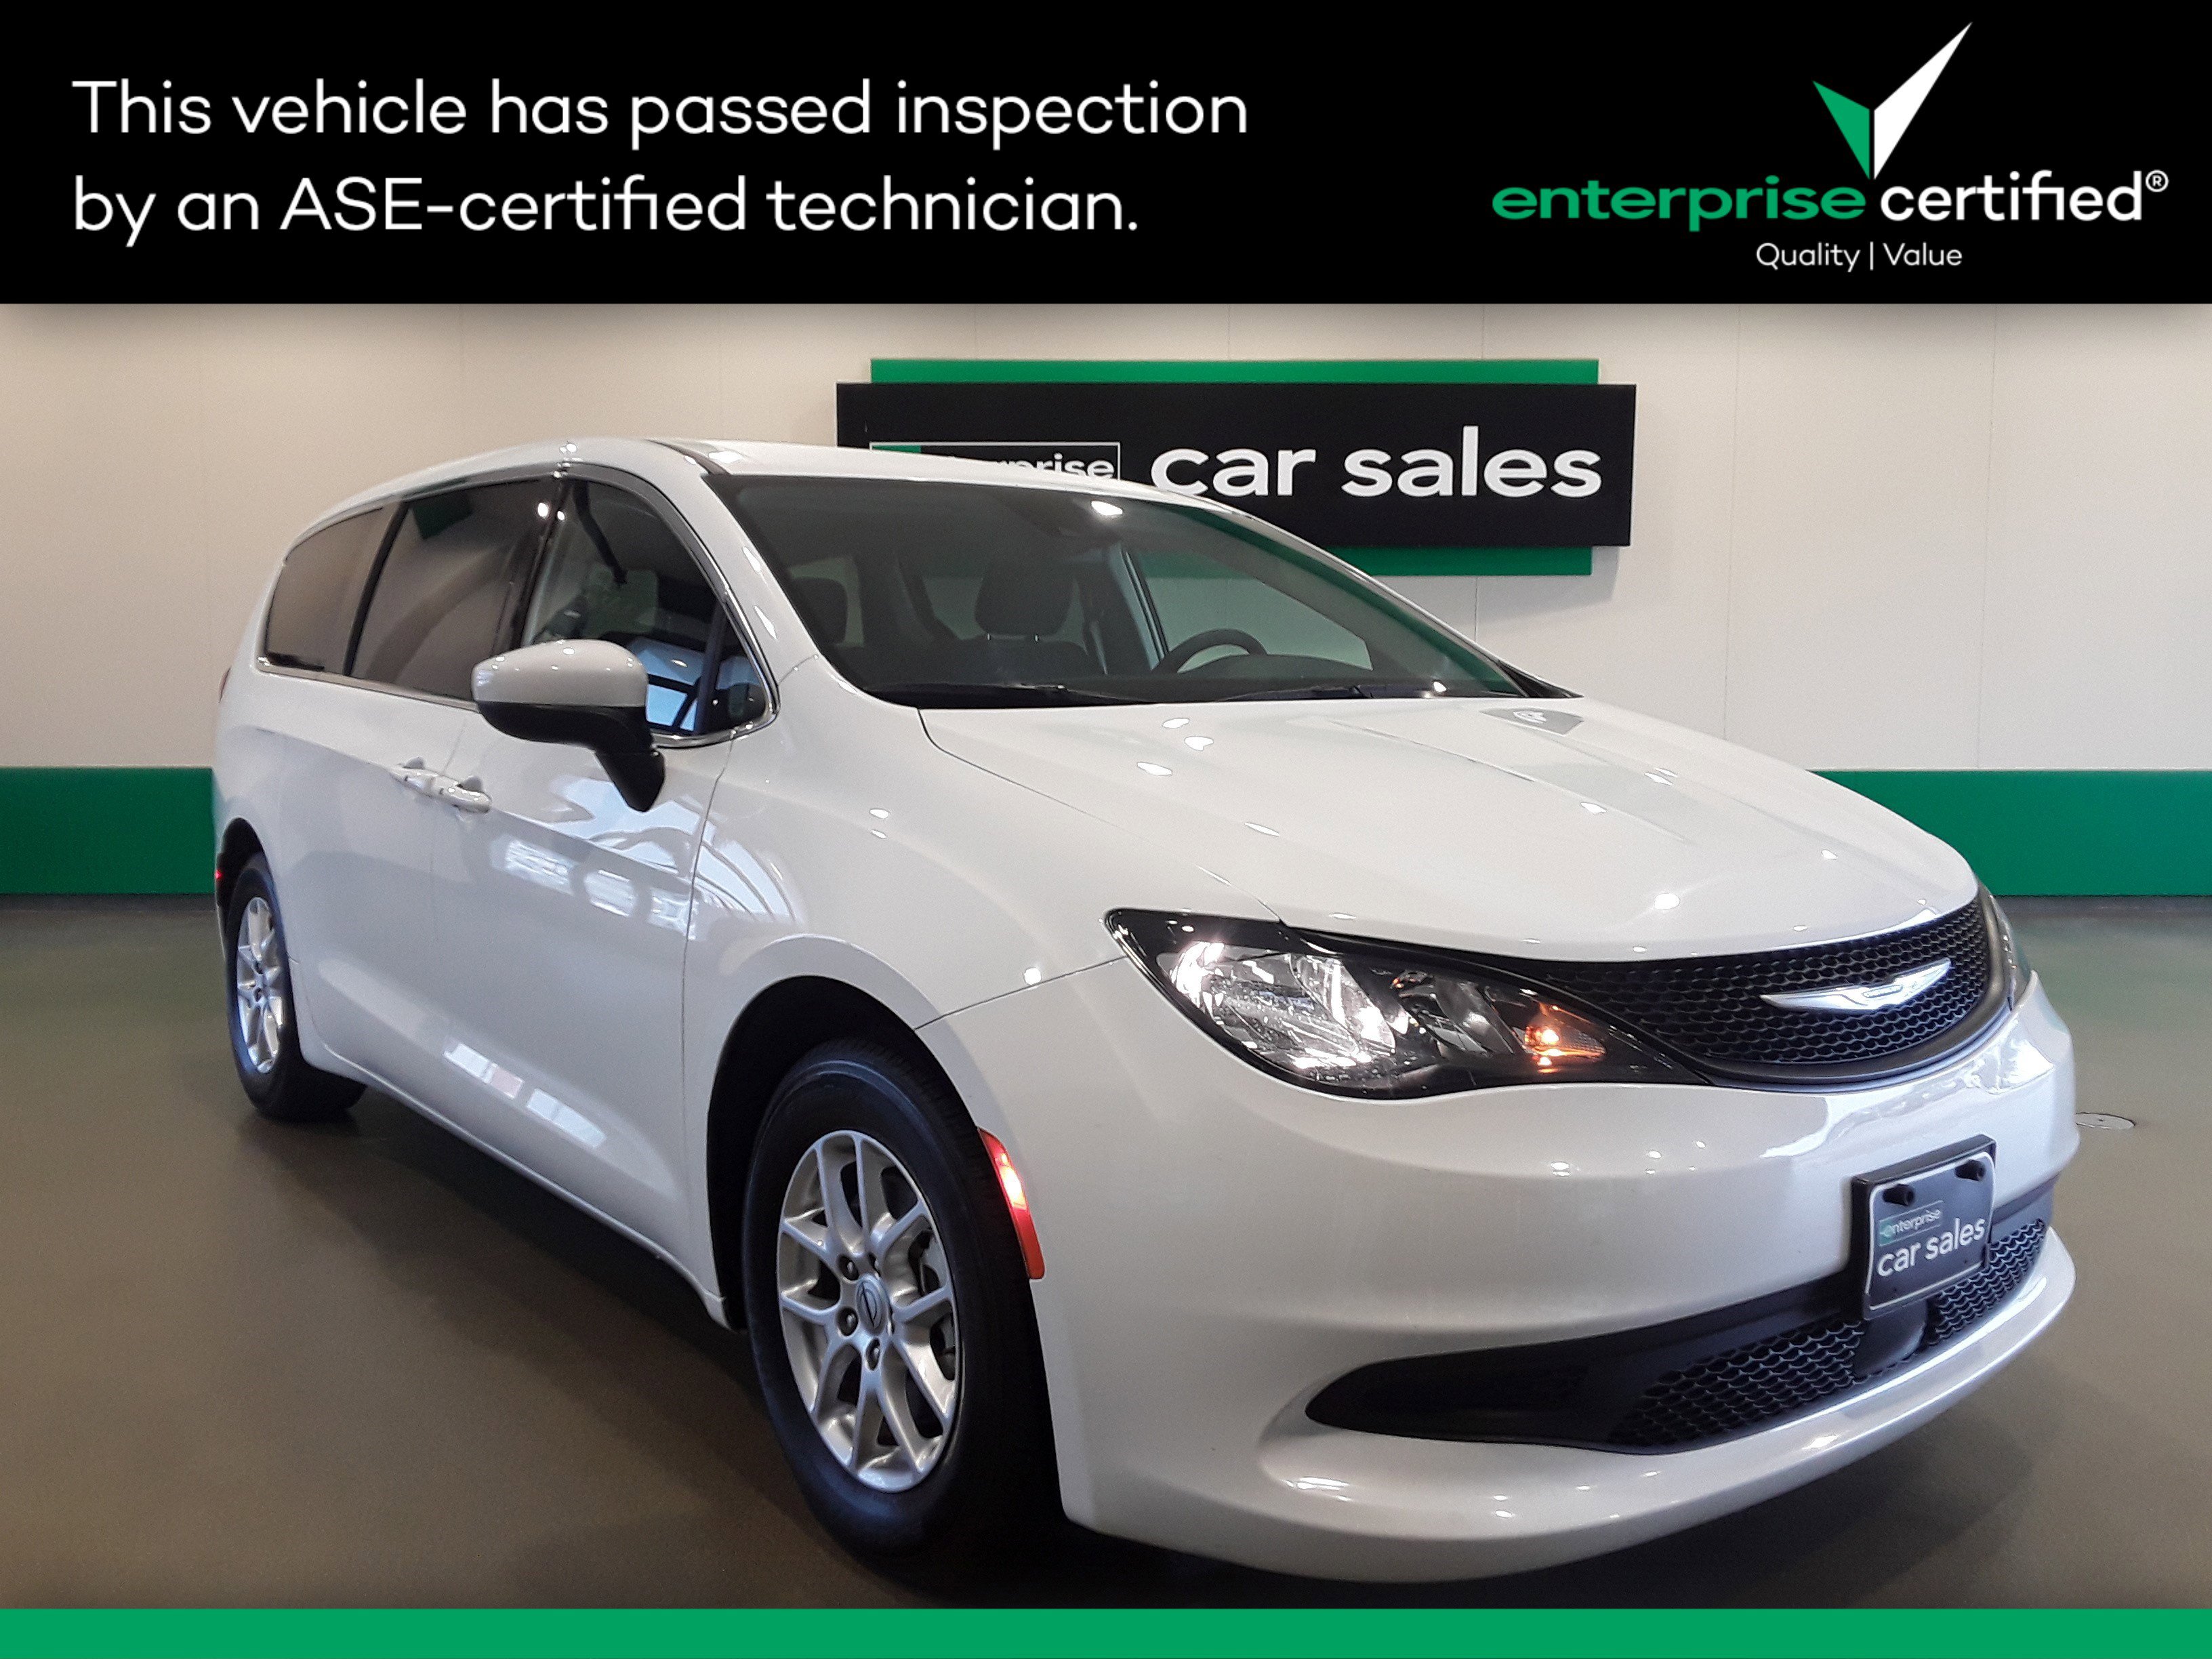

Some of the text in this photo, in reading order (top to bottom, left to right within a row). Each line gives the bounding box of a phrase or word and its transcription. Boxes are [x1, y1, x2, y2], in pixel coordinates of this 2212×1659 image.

[1151, 449, 1316, 497] car
[1341, 426, 1602, 497] sales
[1877, 1218, 1986, 1277] car sales
